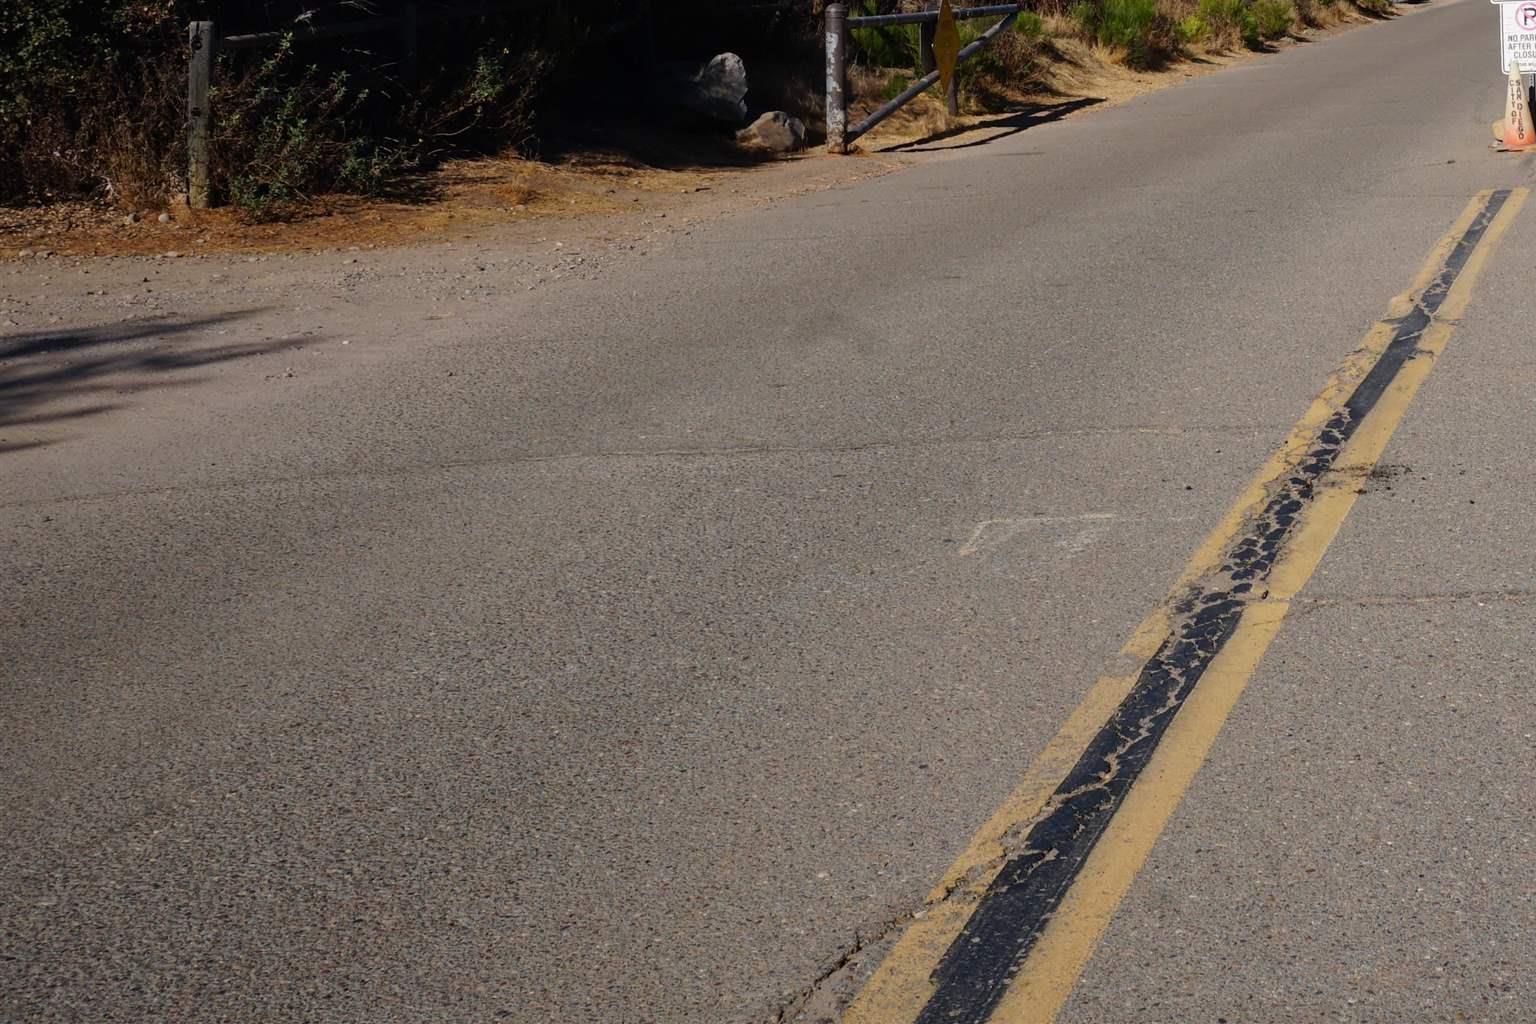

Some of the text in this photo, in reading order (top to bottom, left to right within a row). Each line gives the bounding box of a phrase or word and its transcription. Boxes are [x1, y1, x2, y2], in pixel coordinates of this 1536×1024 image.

[1507, 34, 1518, 42] NO
[1508, 42, 1532, 50] AFTER
[1517, 103, 1525, 140] DIEGO
